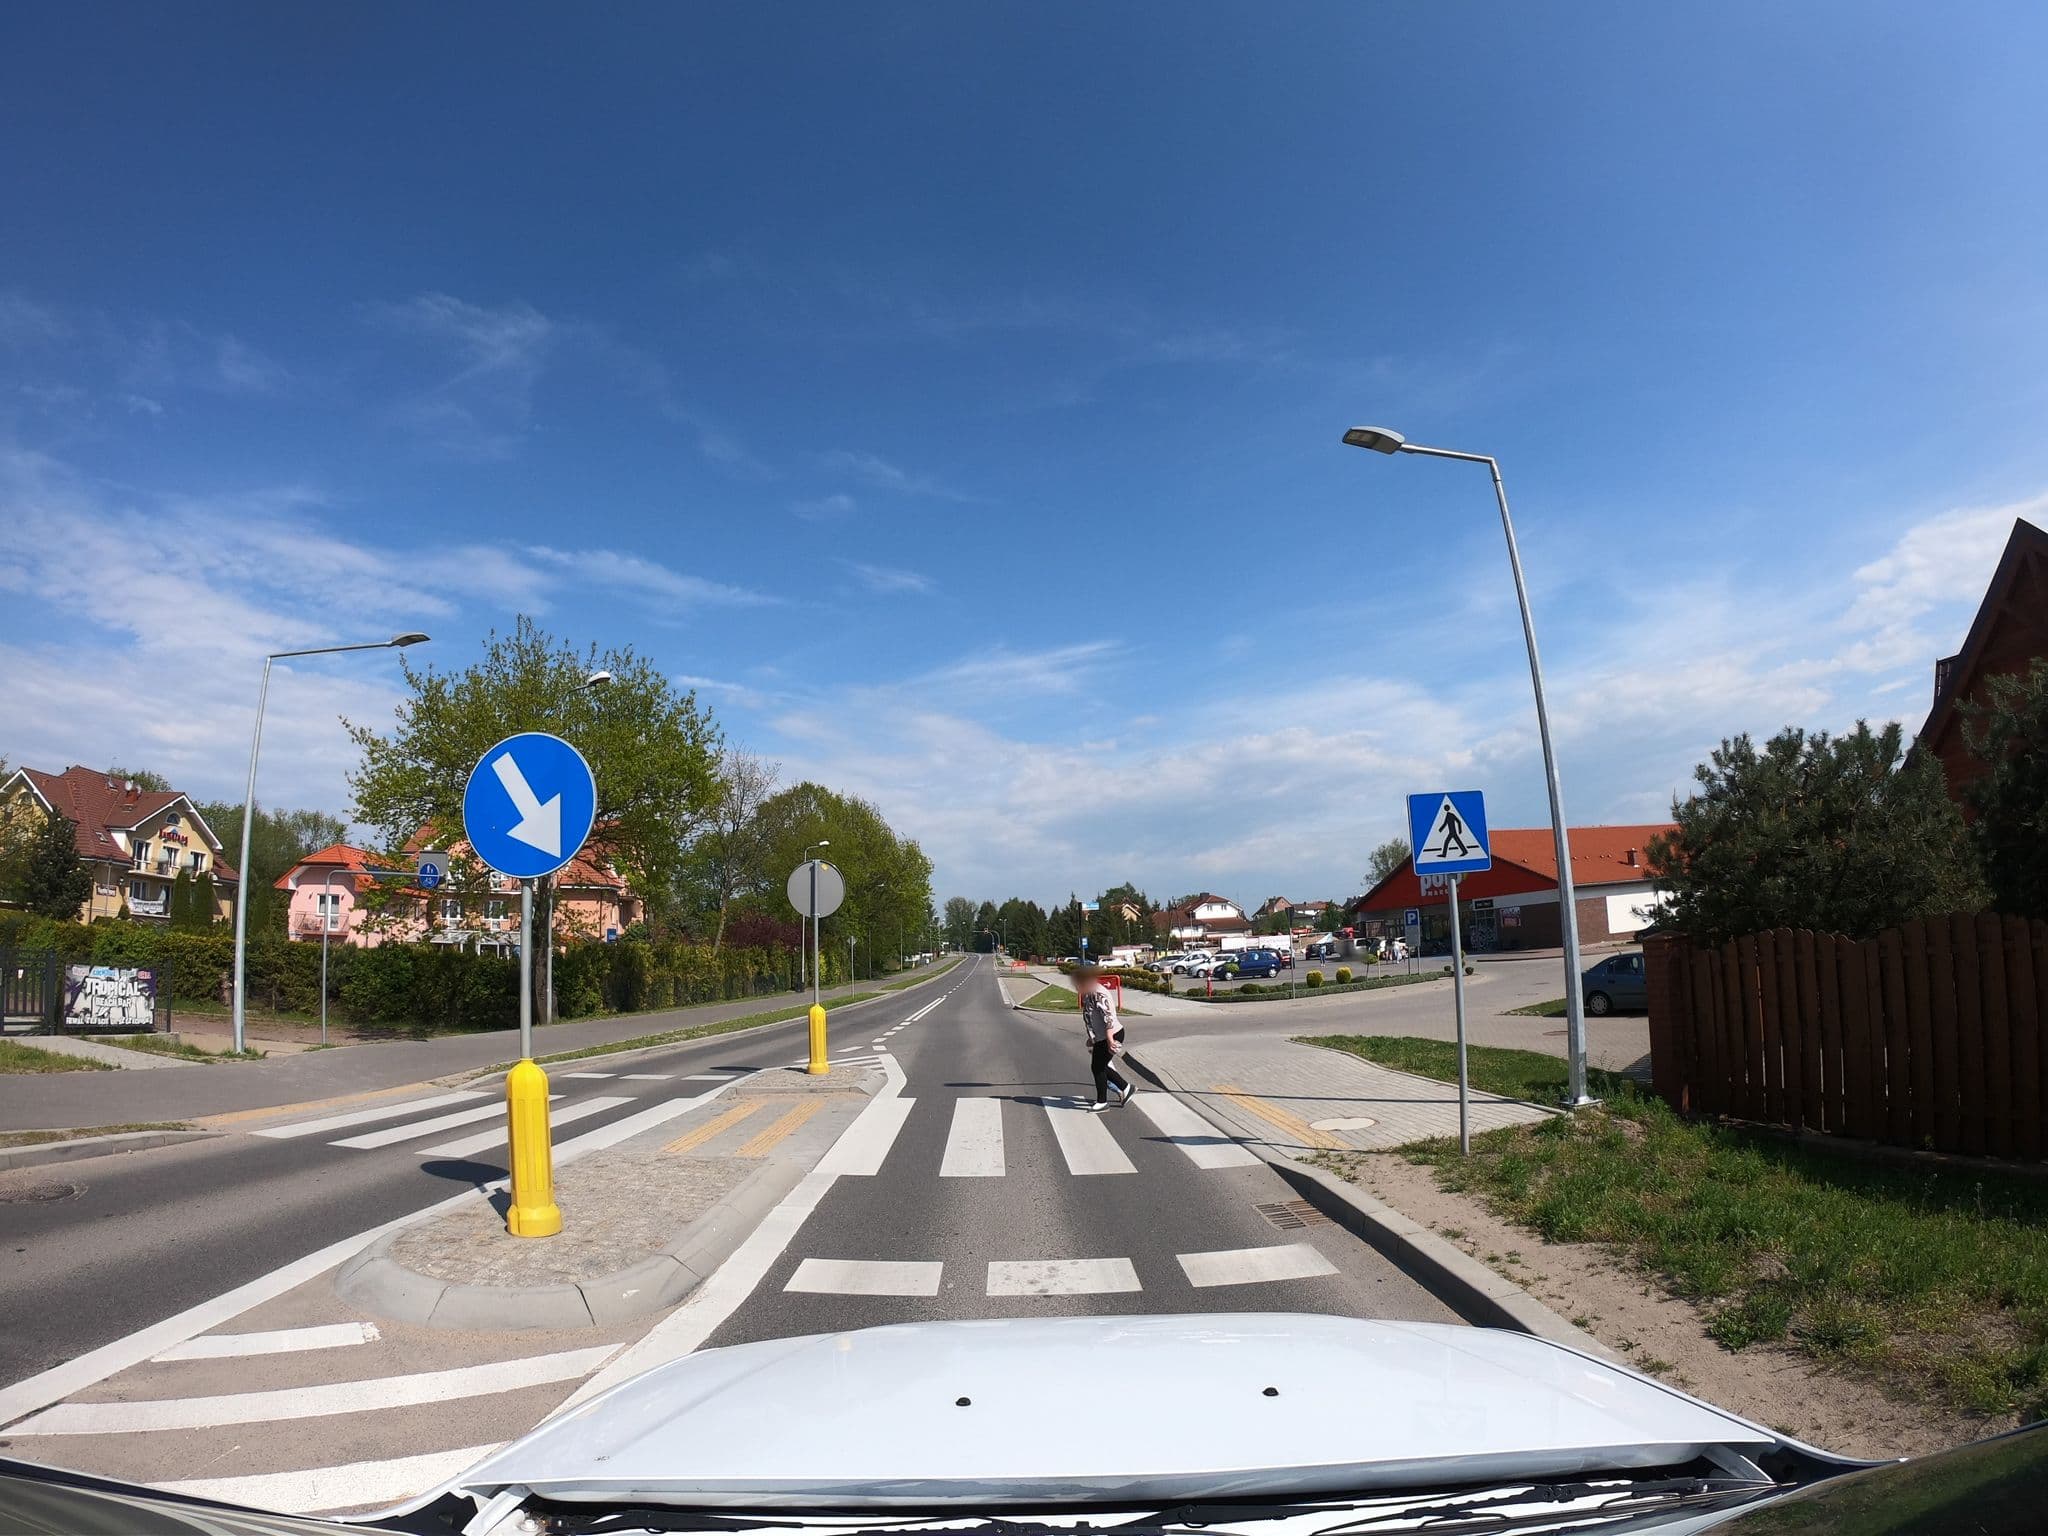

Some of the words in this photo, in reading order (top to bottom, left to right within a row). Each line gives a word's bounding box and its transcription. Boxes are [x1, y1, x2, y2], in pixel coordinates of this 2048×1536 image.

[1407, 913, 1416, 925] P
[85, 978, 141, 996] TROPICAL
[95, 997, 117, 1007] BEACH
[118, 998, 132, 1008] BAR
